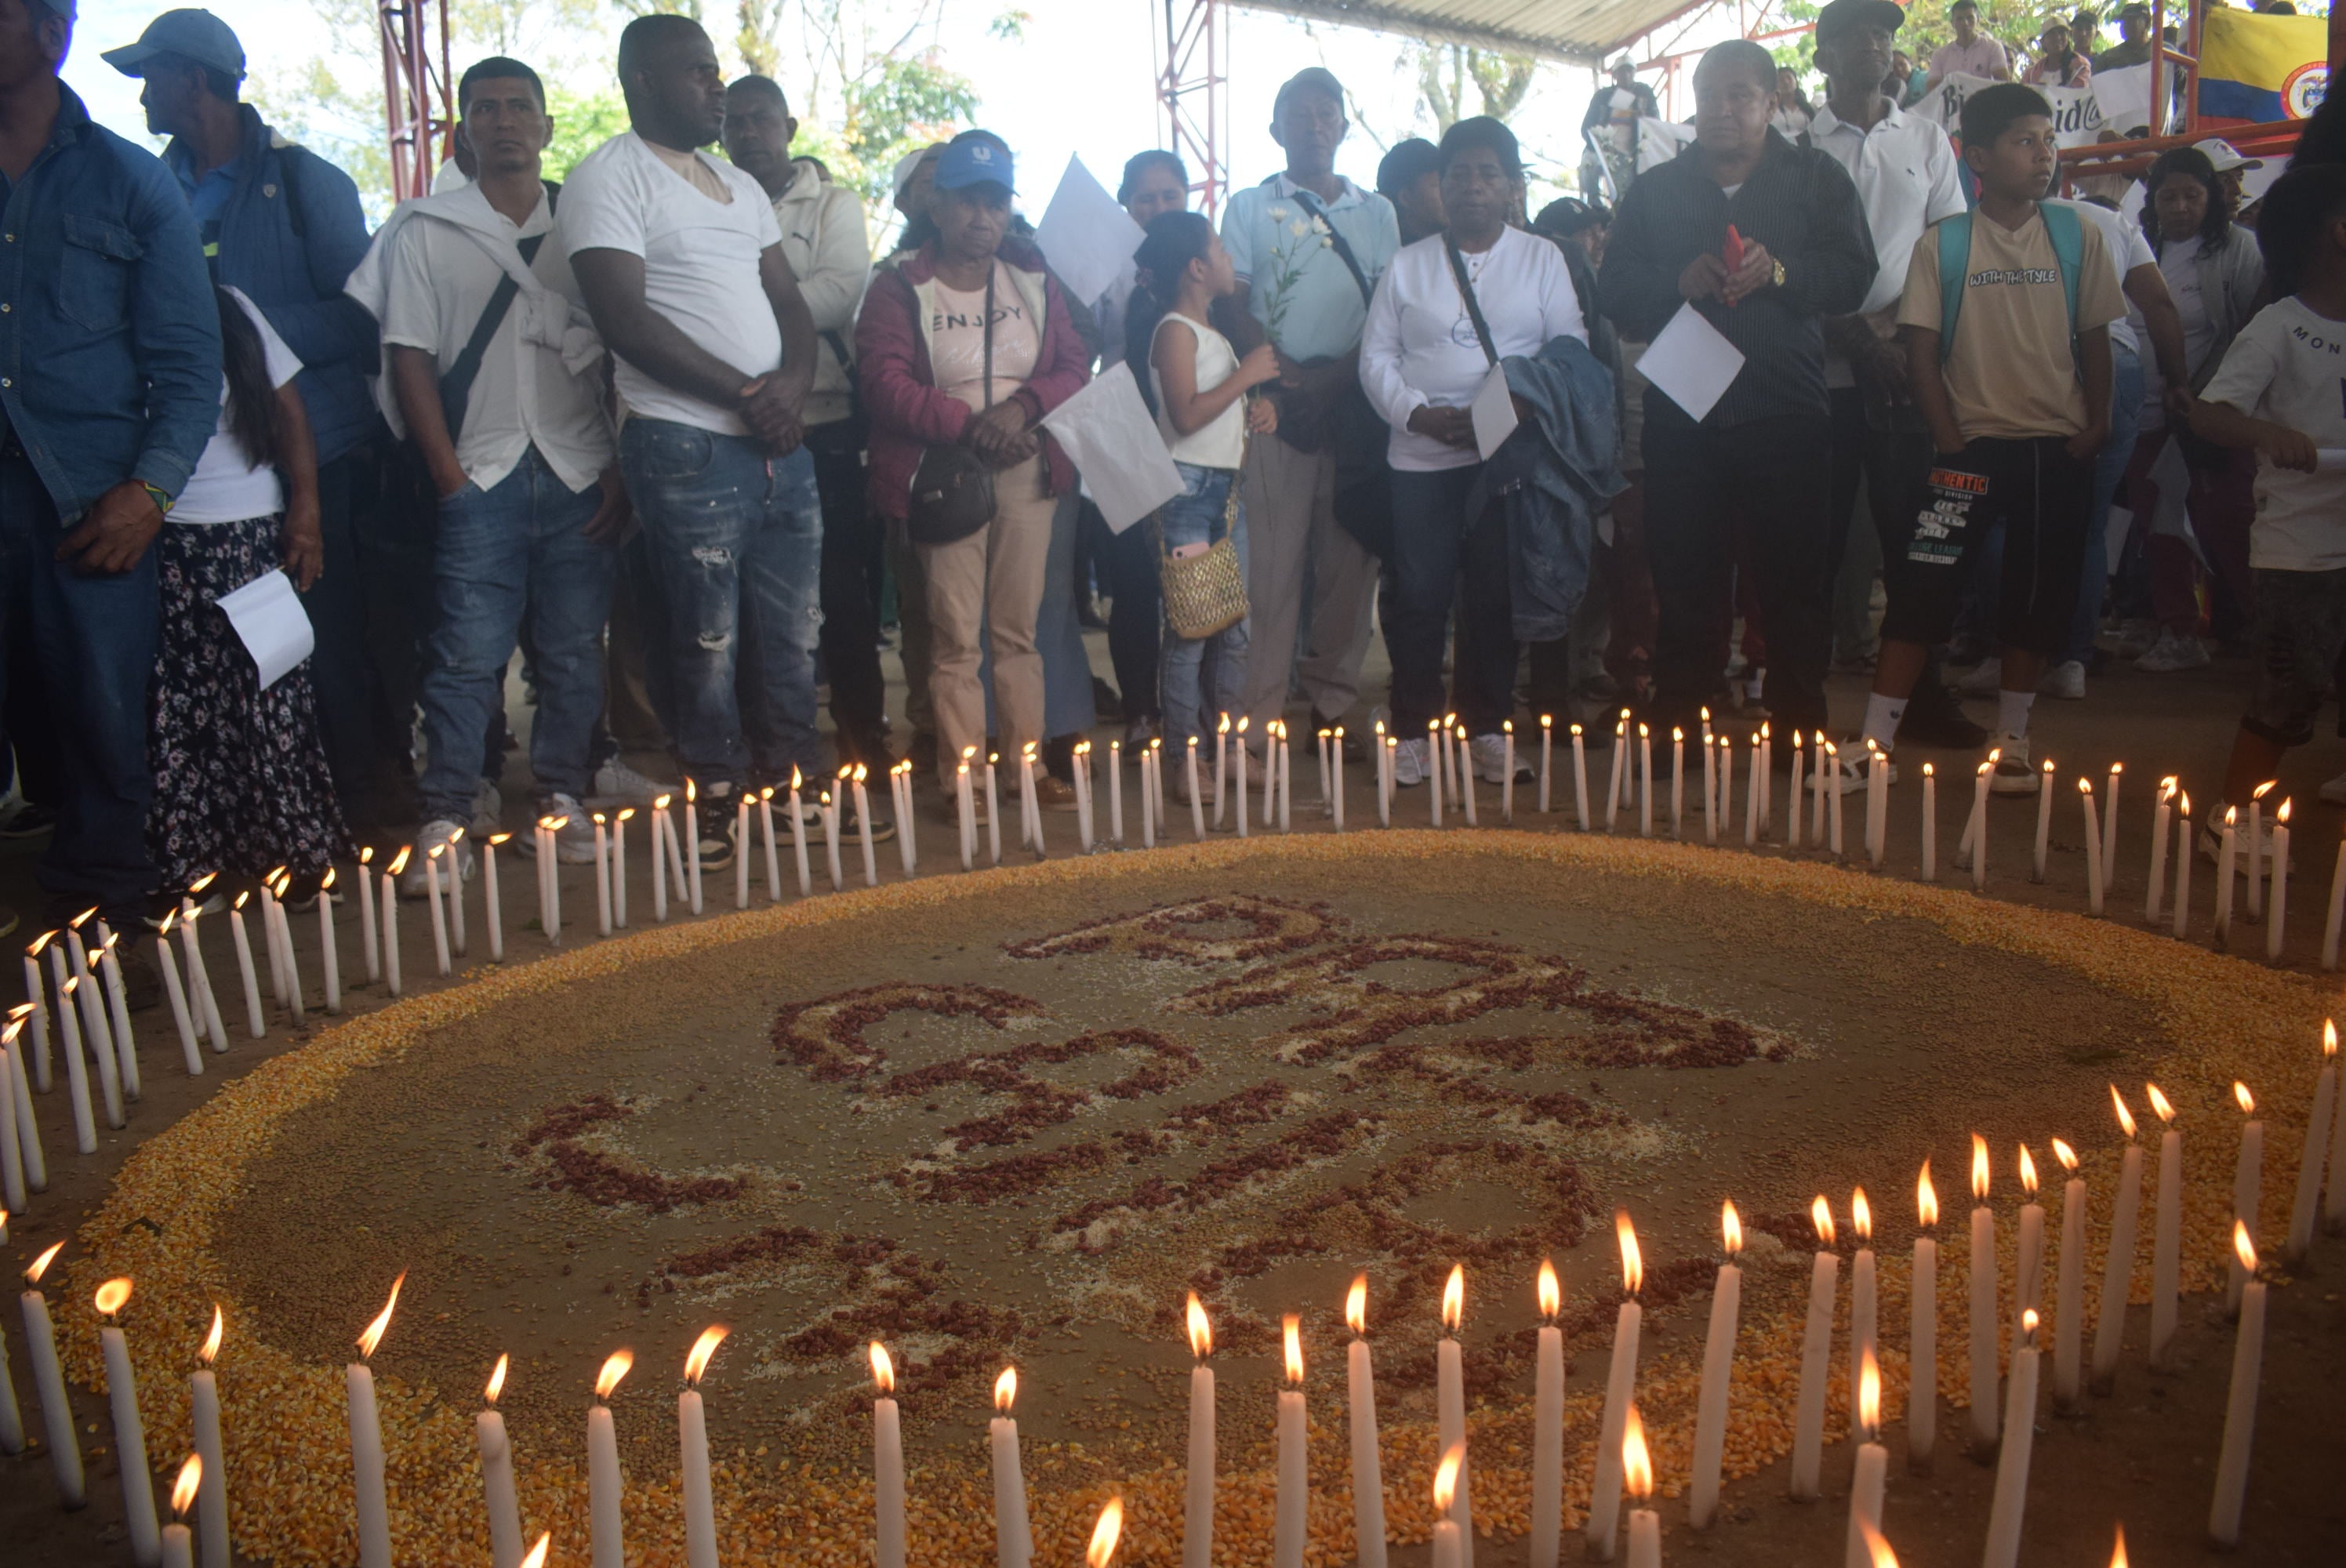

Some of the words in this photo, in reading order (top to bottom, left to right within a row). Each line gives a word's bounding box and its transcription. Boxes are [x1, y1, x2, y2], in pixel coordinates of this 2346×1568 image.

[1969, 270, 2003, 288] WITH
[2025, 268, 2057, 284] TYLE
[932, 305, 1021, 332] ENJOY
[2293, 326, 2341, 354] MON
